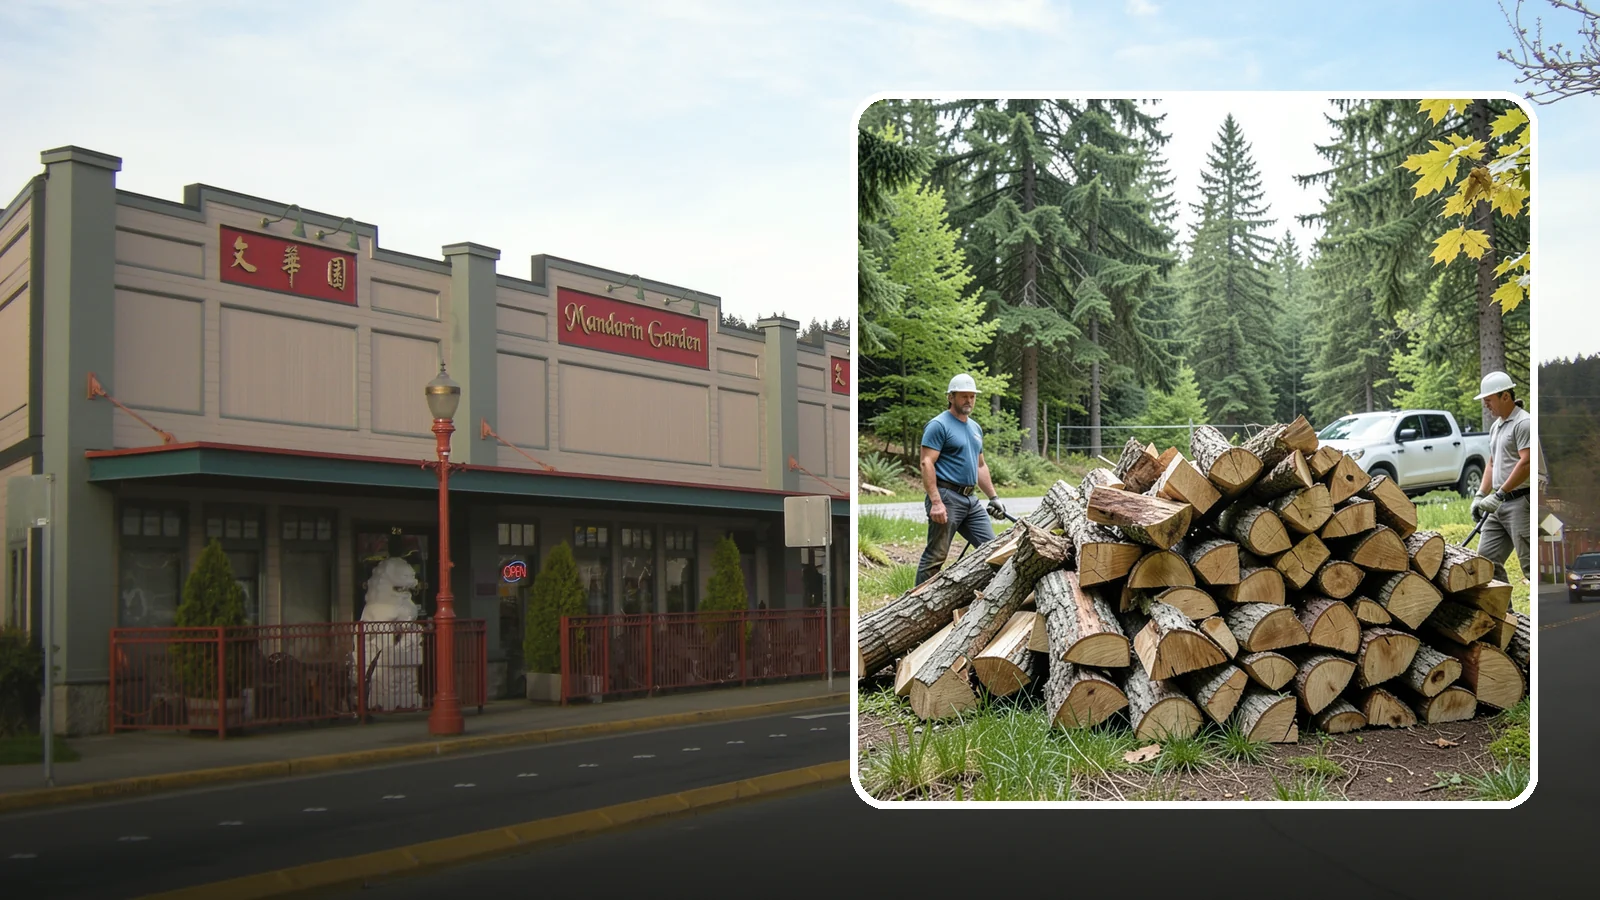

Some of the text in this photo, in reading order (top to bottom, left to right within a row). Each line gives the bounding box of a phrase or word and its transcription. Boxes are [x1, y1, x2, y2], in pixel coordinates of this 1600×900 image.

[231, 235, 346, 291] 文華園
[564, 302, 701, 352] Mandarin Garden
[834, 362, 846, 386] 文
[503, 565, 527, 578] OPEN
